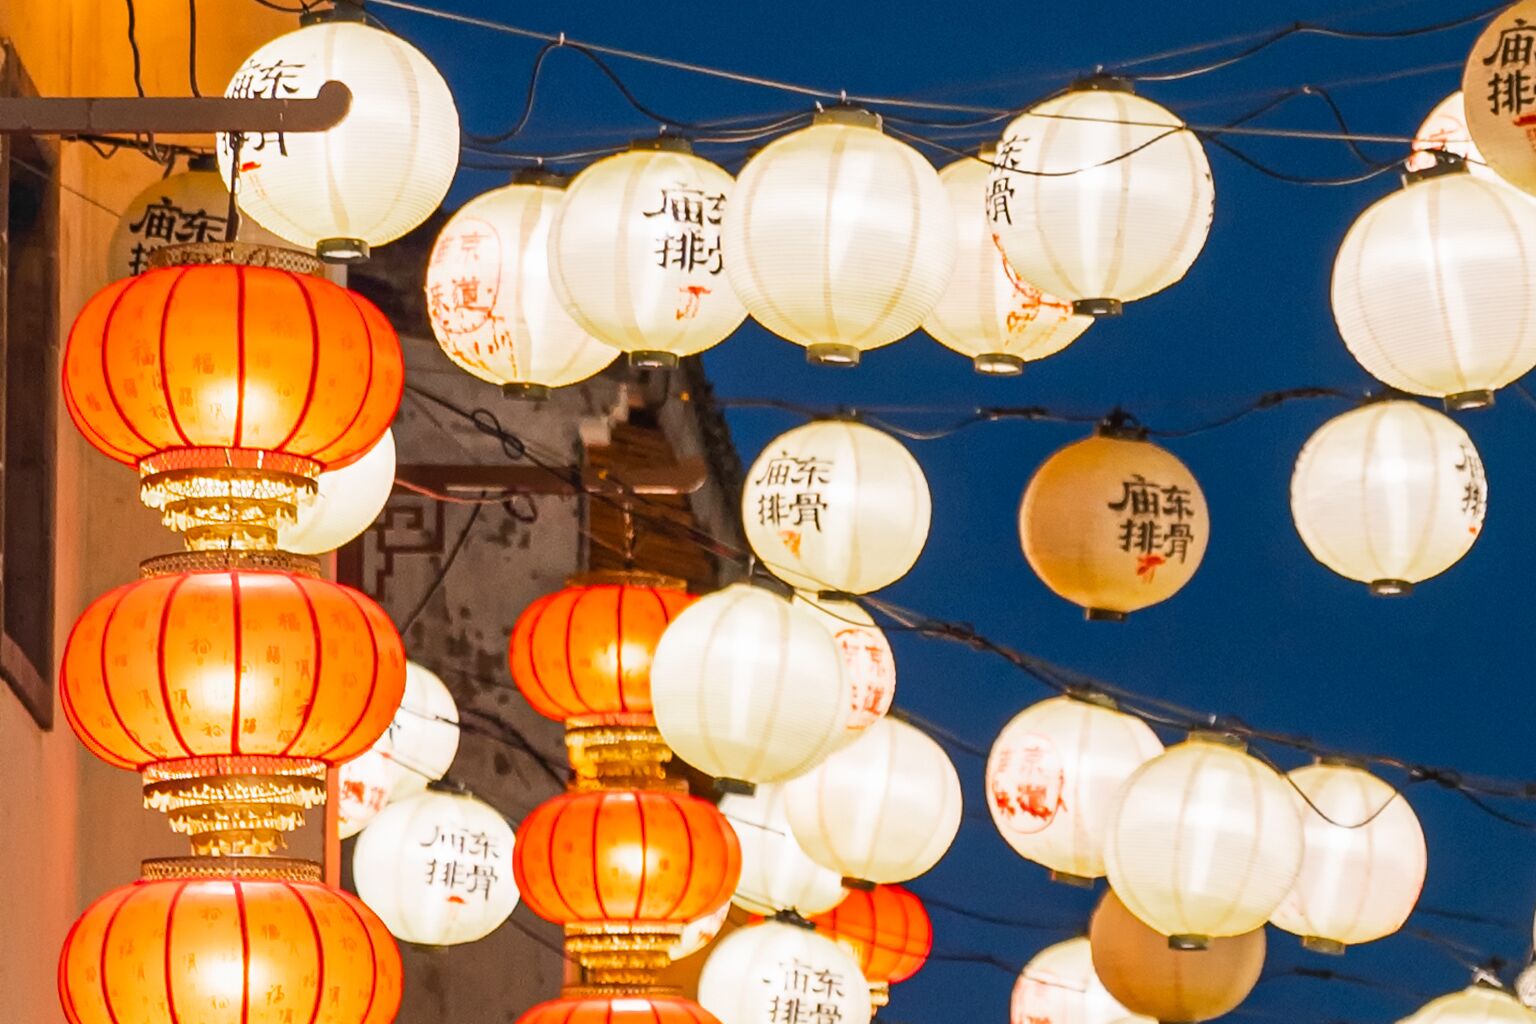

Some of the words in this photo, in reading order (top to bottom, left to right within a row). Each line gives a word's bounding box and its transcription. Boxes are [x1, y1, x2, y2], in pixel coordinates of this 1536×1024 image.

[755, 450, 834, 488] 庙东
[757, 491, 829, 533] 排骨
[1107, 473, 1195, 521] 庙东
[1117, 518, 1195, 565] 排骨
[425, 859, 499, 901] 排骨
